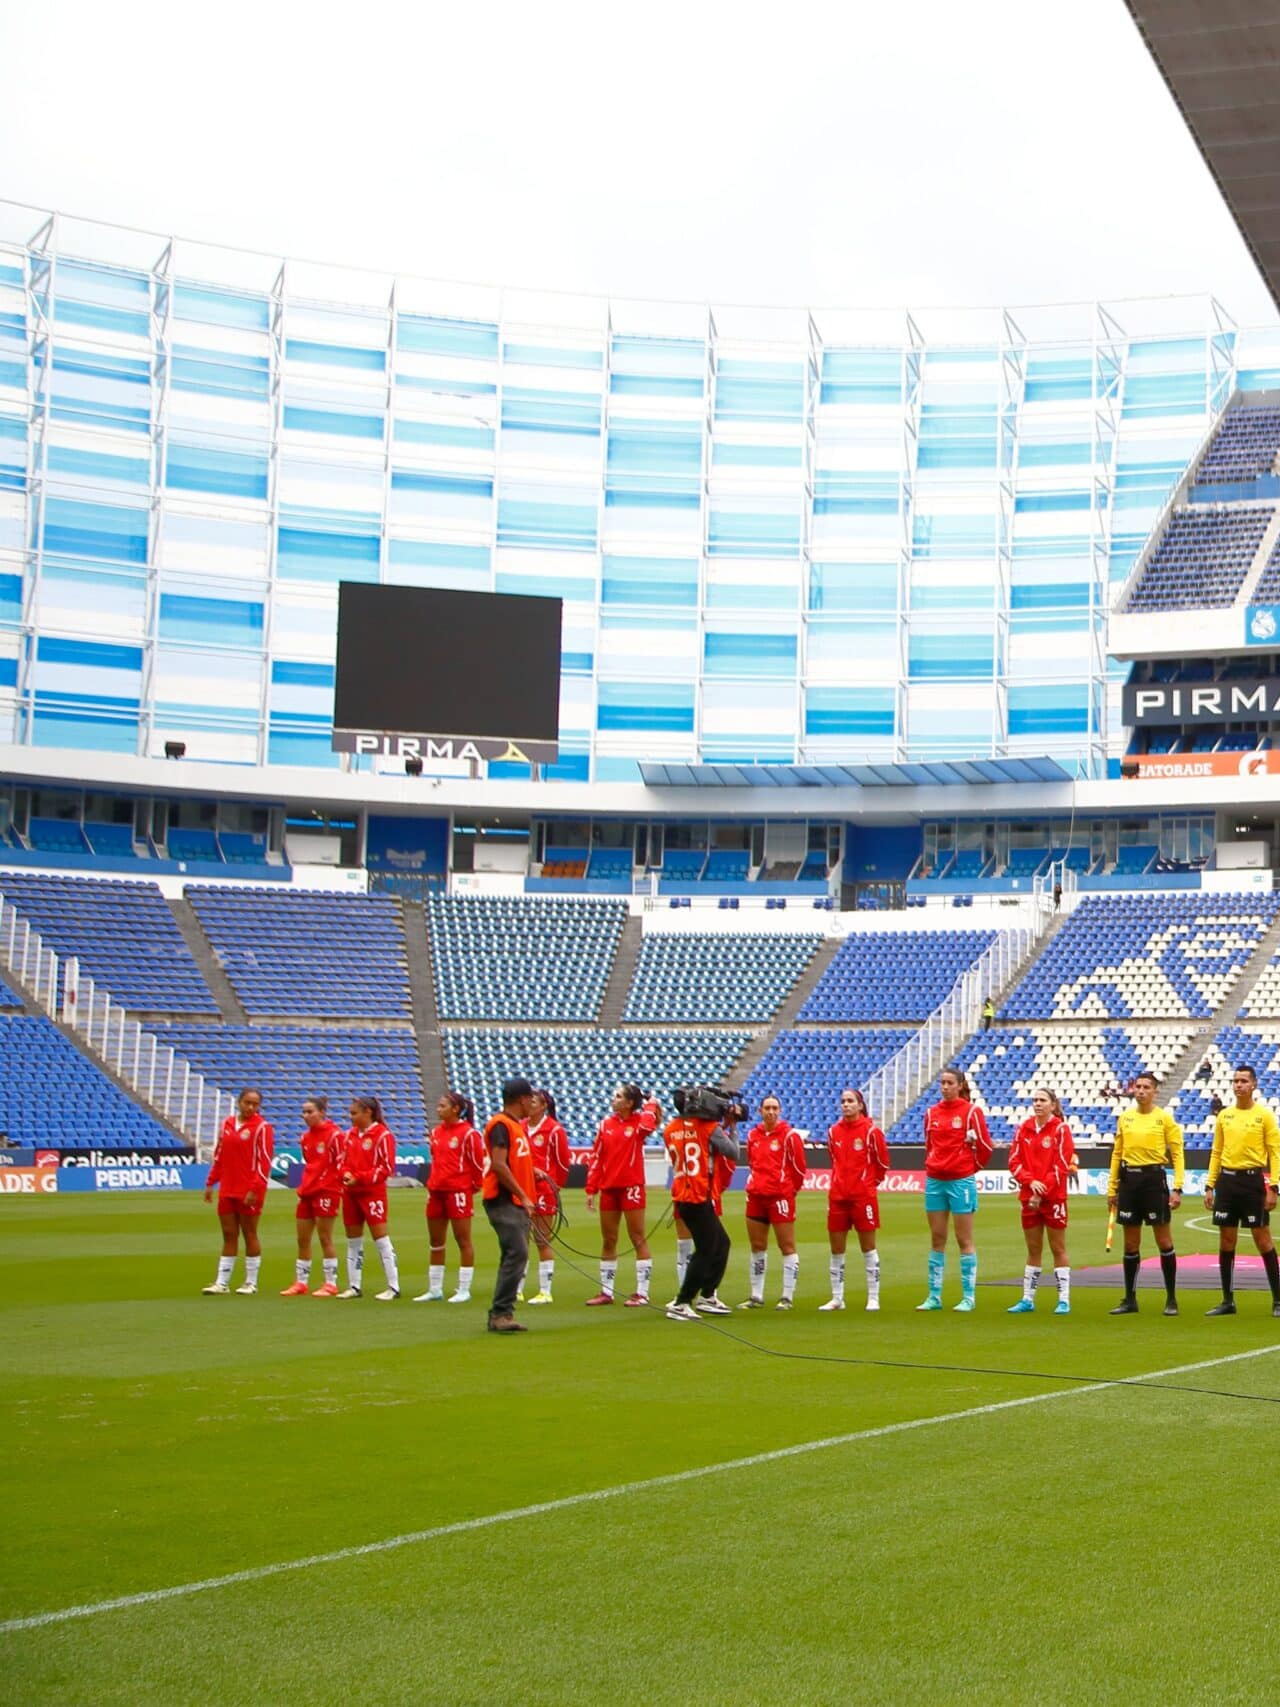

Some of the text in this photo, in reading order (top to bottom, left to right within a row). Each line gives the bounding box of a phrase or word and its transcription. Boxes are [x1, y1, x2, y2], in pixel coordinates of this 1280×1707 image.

[356, 736, 482, 761] PIRMA
[62, 1151, 195, 1167] calientemx
[95, 1169, 182, 1188] PERDURA
[976, 1176, 1003, 1191] obil
[455, 1192, 466, 1207] 13
[627, 1185, 640, 1200] 22
[369, 1200, 384, 1215] 23
[1053, 1203, 1067, 1219] 24
